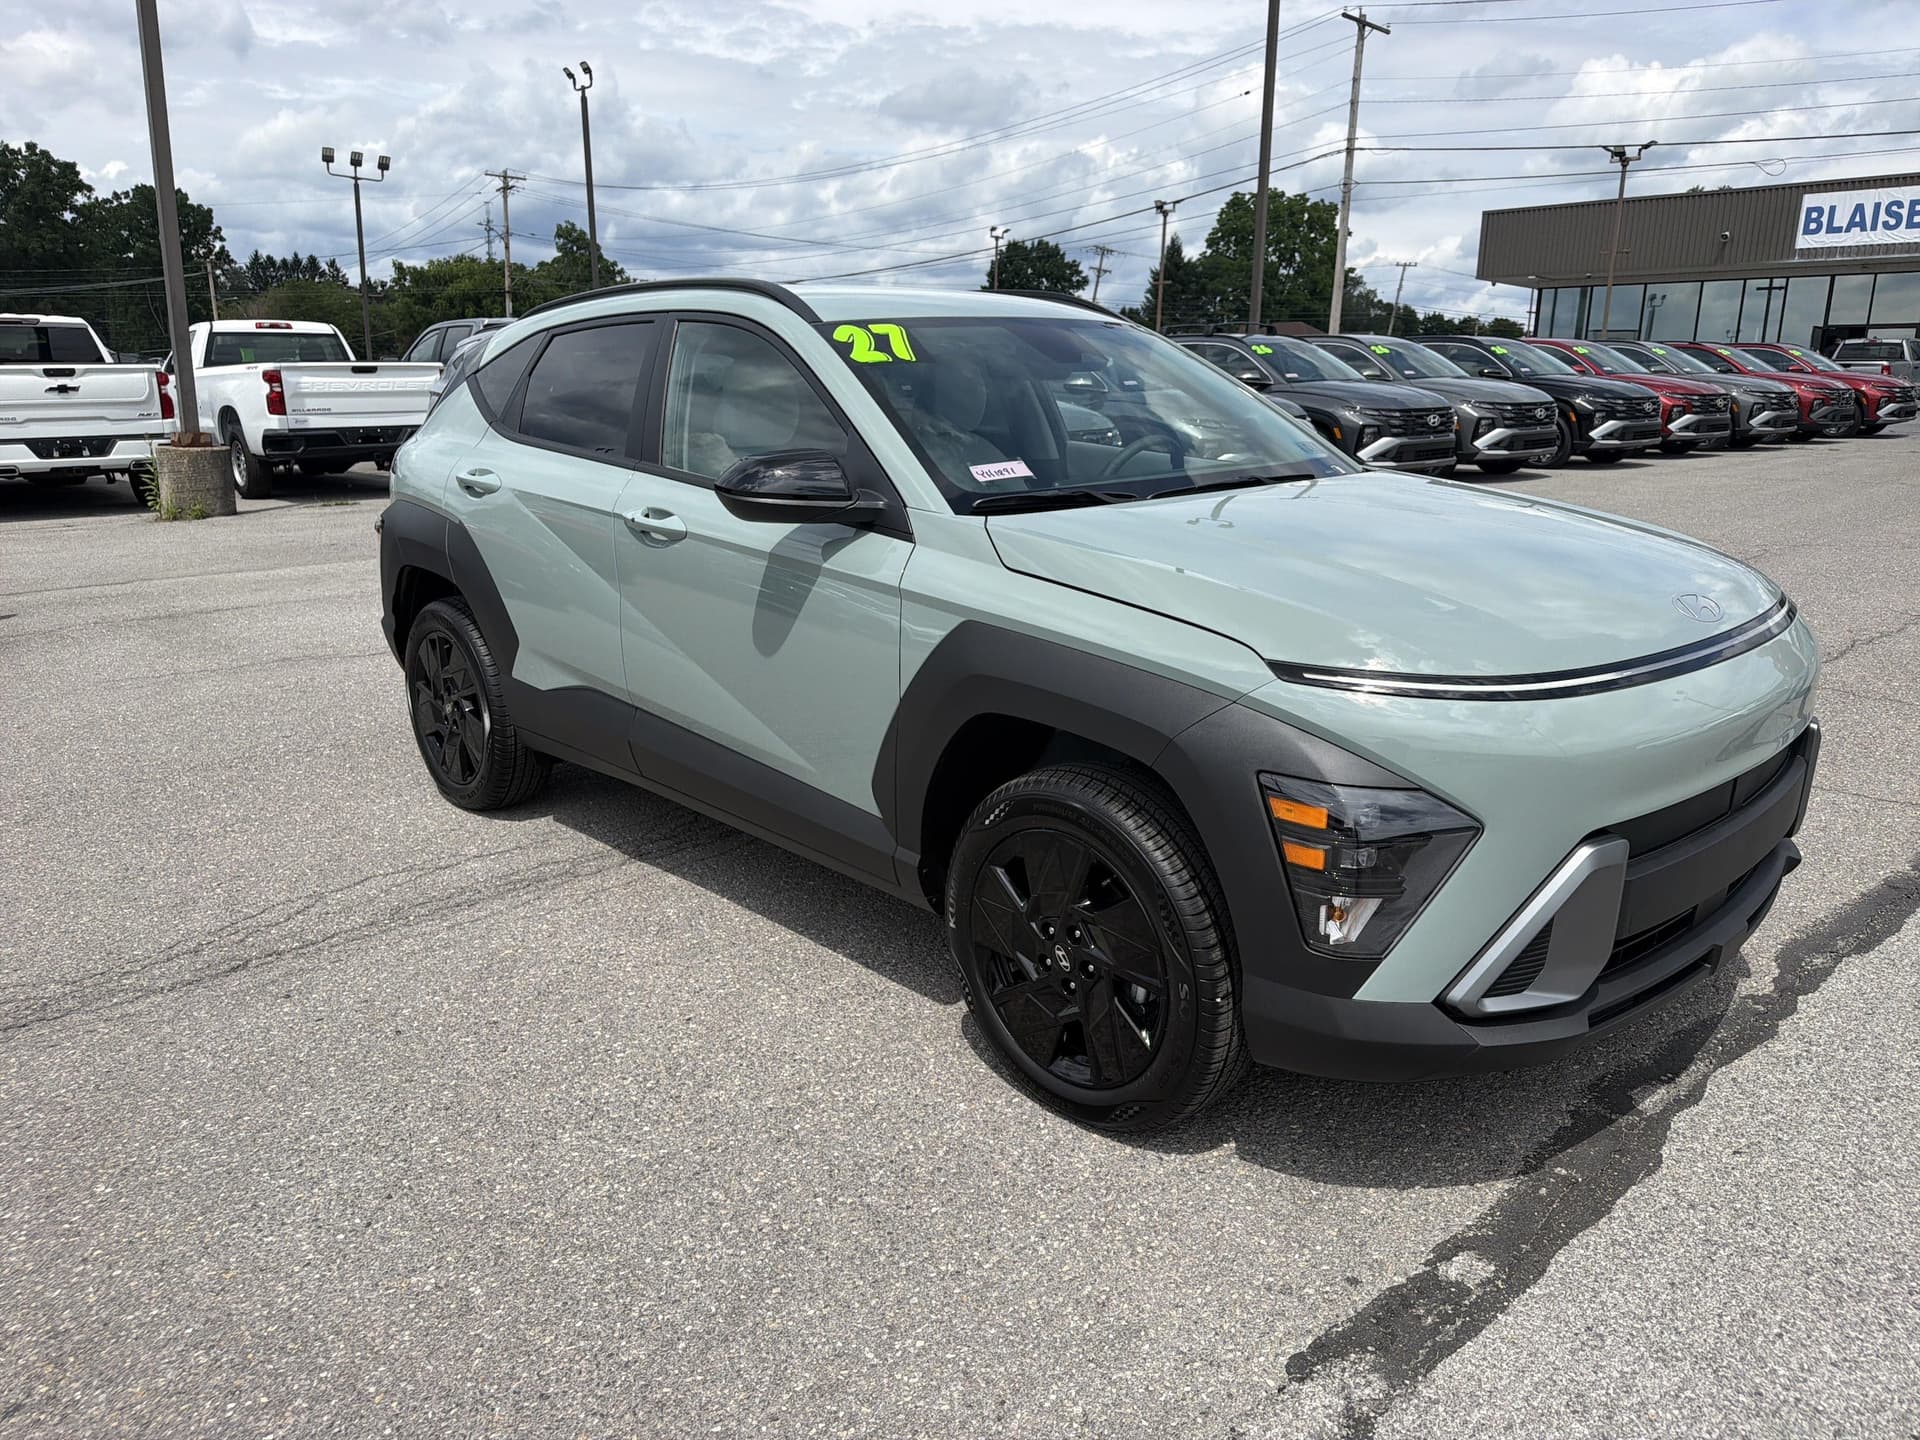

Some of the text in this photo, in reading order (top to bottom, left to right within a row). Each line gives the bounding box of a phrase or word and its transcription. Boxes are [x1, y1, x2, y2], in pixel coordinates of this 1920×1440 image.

[1801, 199, 1920, 236] BLAISE
[832, 324, 917, 363] 27
[1251, 344, 1273, 355] 26
[1370, 344, 1391, 355] 26
[297, 381, 433, 392] CHEVROLET
